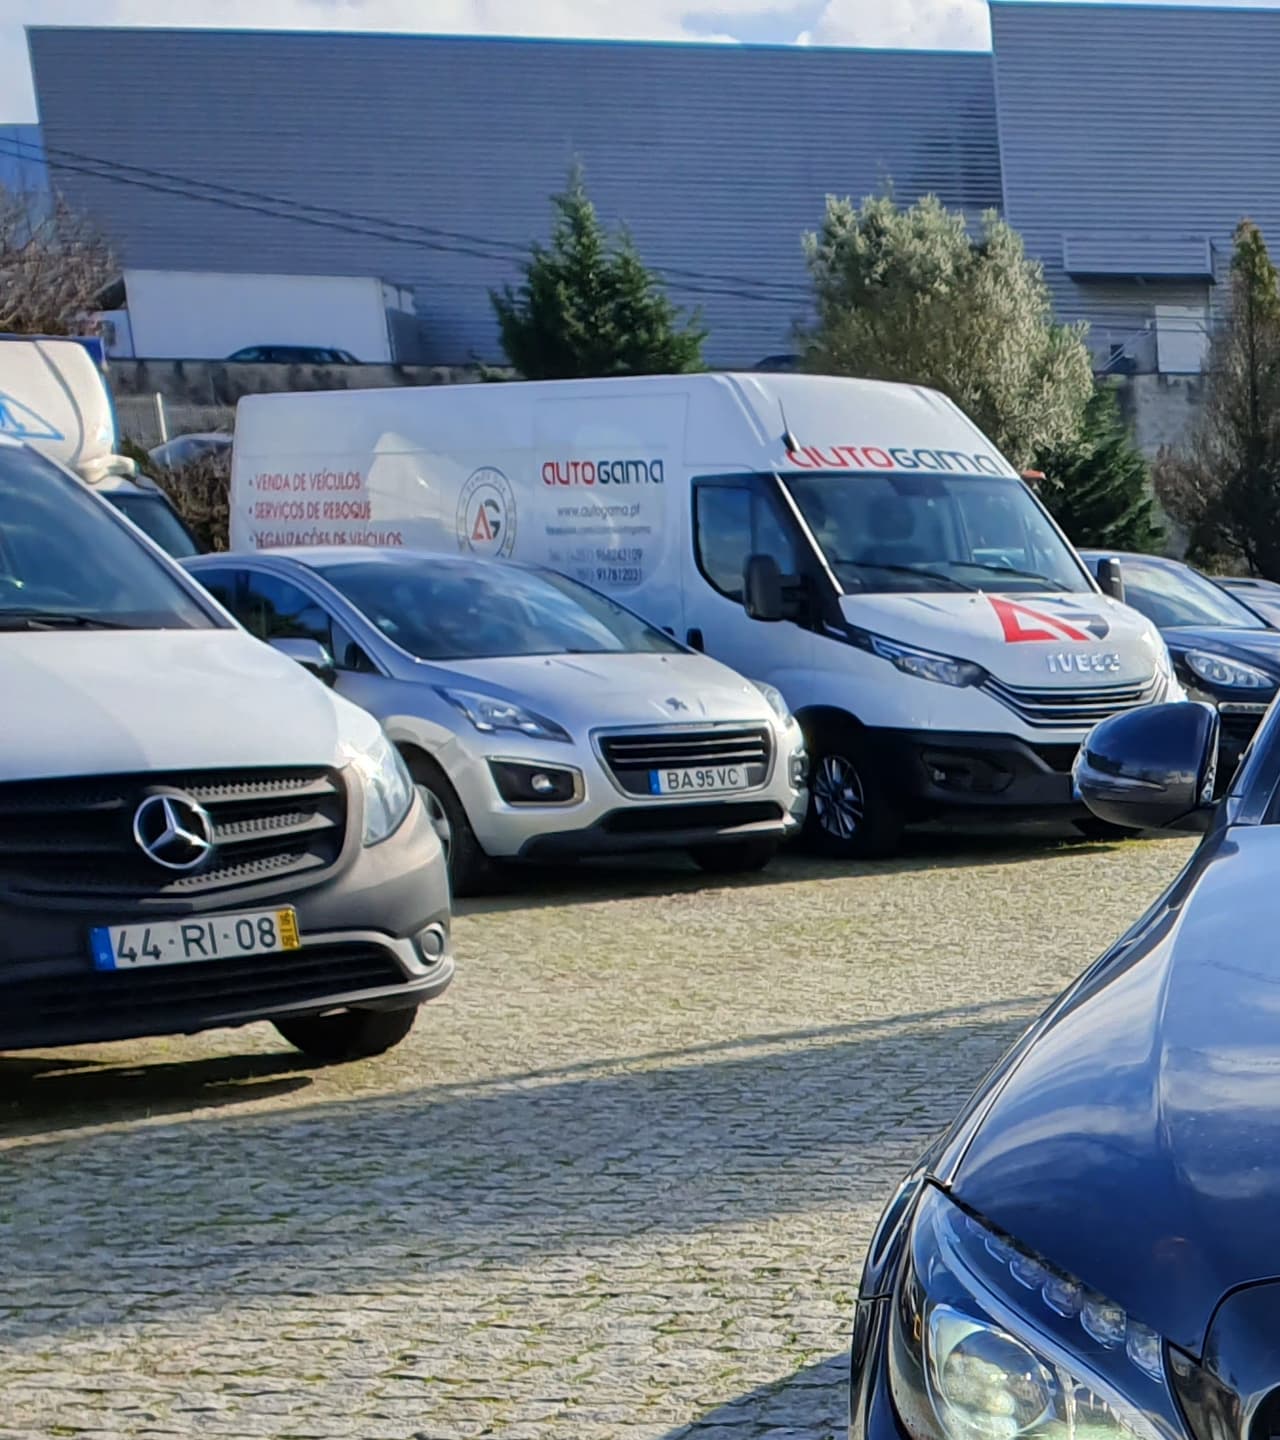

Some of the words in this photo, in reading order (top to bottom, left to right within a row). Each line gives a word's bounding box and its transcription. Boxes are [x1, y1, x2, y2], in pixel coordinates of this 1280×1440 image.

[255, 472, 290, 491] VENDA
[293, 473, 306, 491] DE
[307, 501, 320, 520] DE
